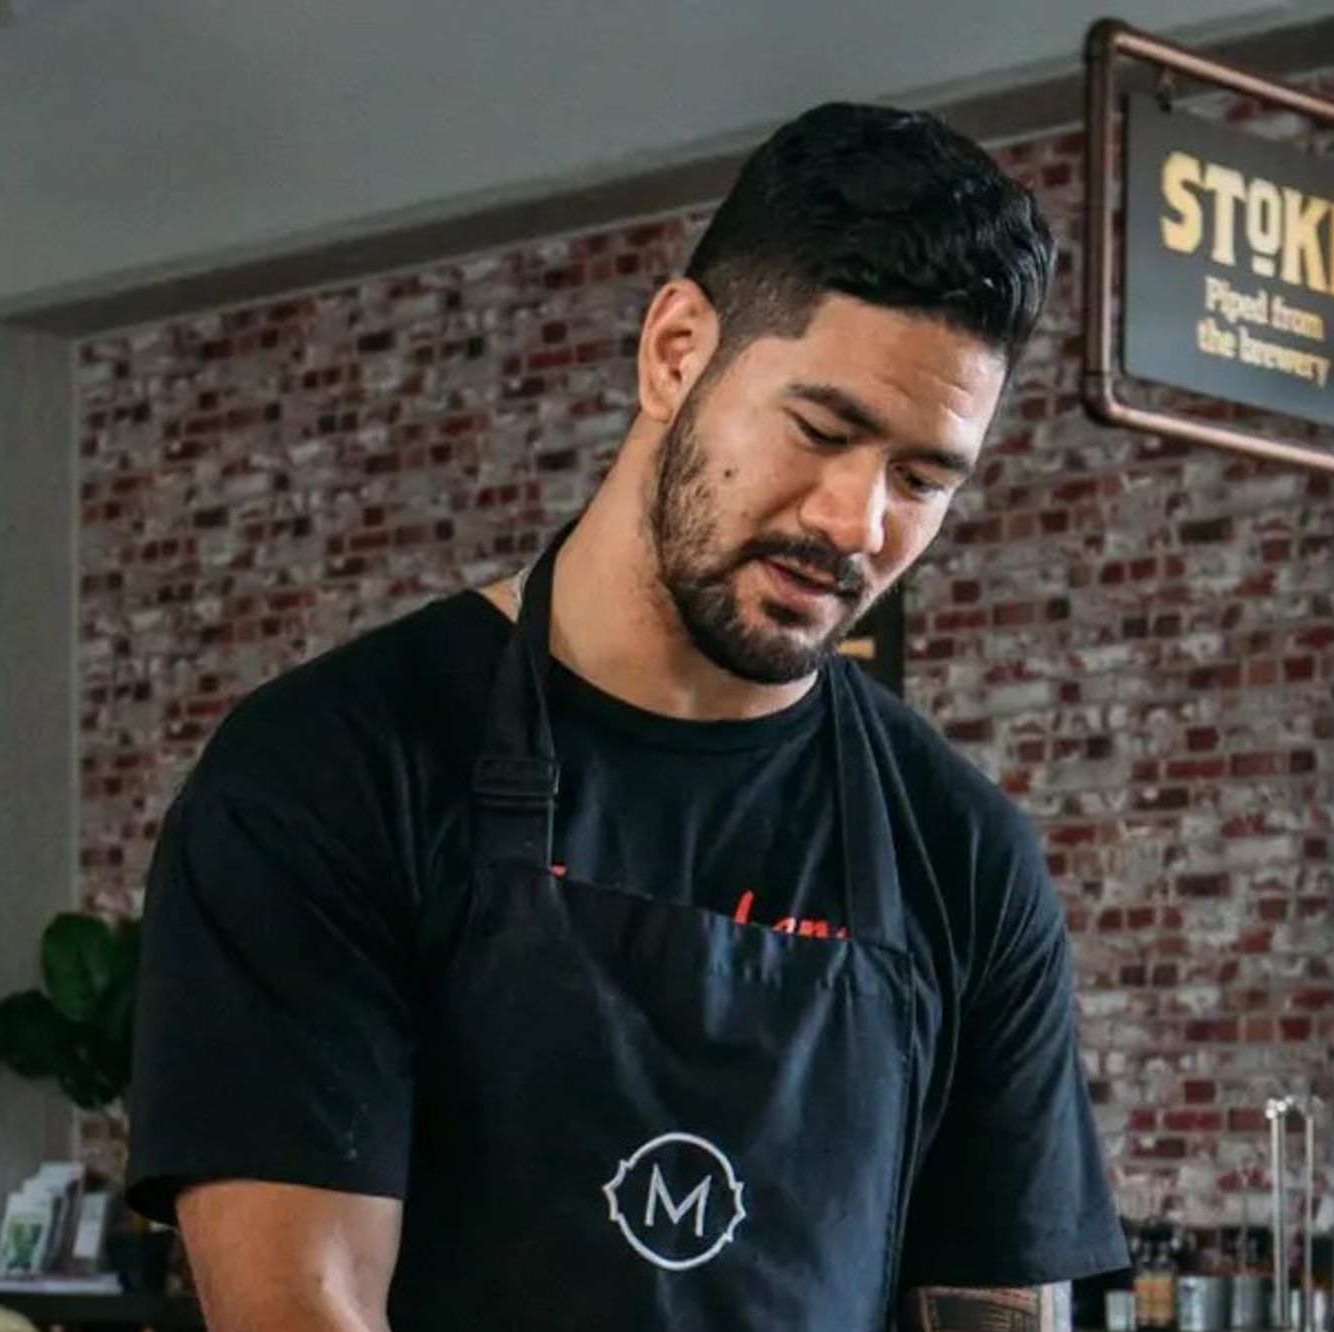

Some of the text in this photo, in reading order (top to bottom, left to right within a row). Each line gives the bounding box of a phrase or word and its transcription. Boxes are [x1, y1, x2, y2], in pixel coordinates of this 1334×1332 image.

[1197, 317, 1331, 388] the brewery
[1271, 295, 1325, 342] from
[644, 1162, 713, 1238] M
